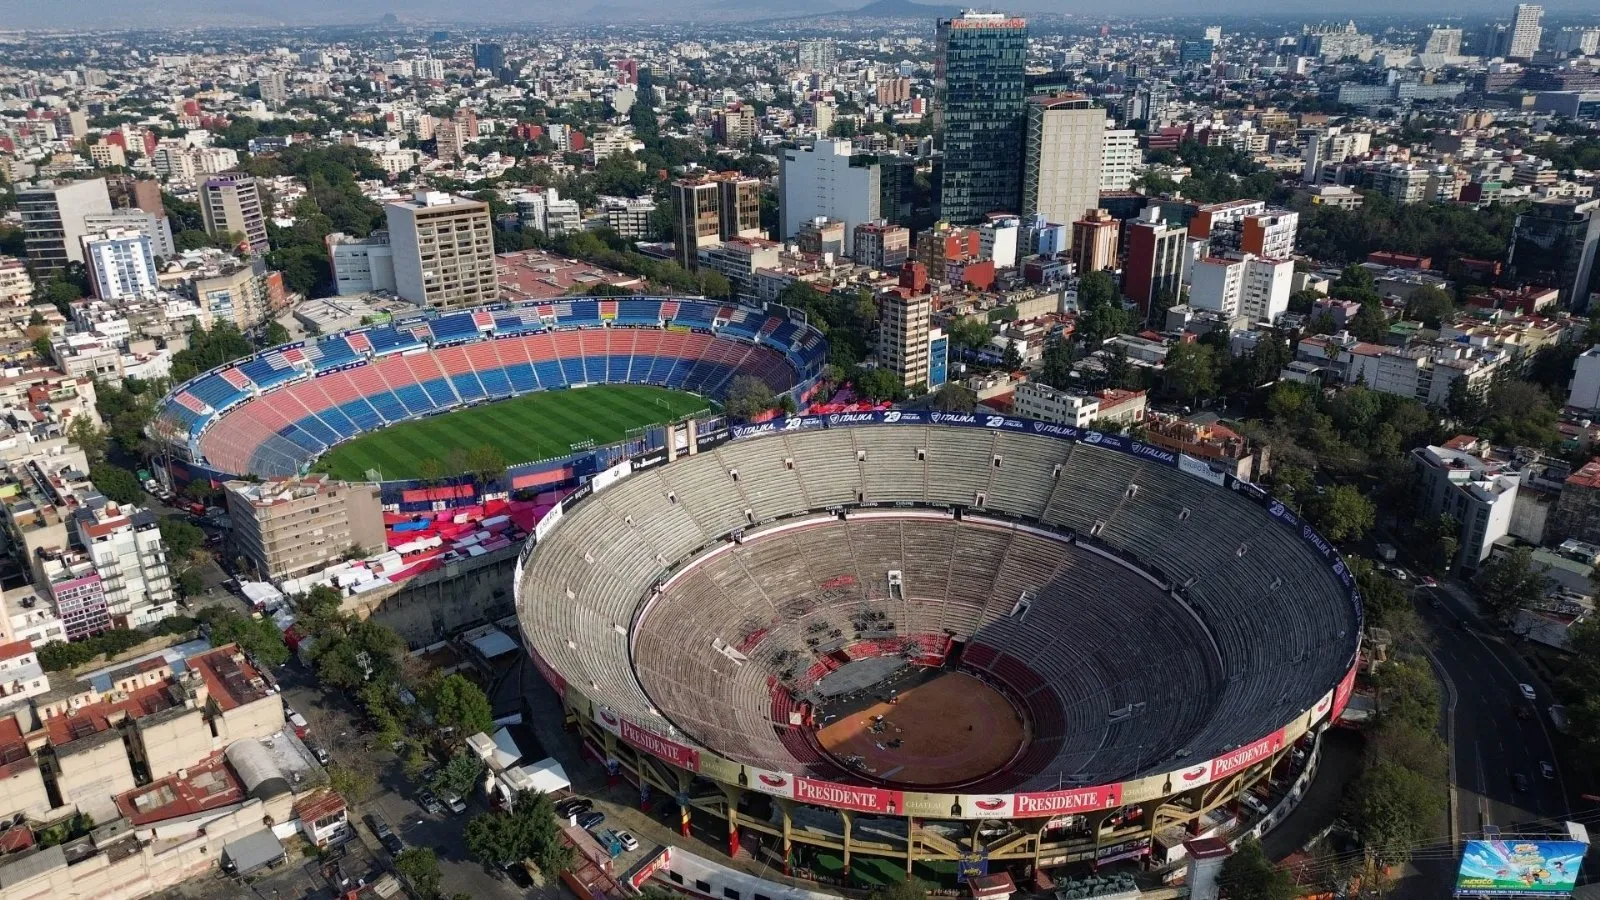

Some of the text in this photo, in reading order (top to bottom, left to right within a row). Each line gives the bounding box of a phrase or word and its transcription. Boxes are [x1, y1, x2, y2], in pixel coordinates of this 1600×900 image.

[839, 413, 873, 422] ITALIKA
[940, 414, 975, 423] ITALIKA
[742, 422, 775, 435] ITALIKA
[1043, 424, 1078, 437] ITALIKA
[1140, 446, 1175, 462] ITALIKA
[1309, 532, 1331, 557] ITALIKA
[623, 724, 680, 761] PRESIDENTE
[1214, 740, 1270, 776] PRESIDENTE
[797, 779, 878, 808] PRESIDENTE
[1018, 791, 1098, 812] PRESIDENTE
